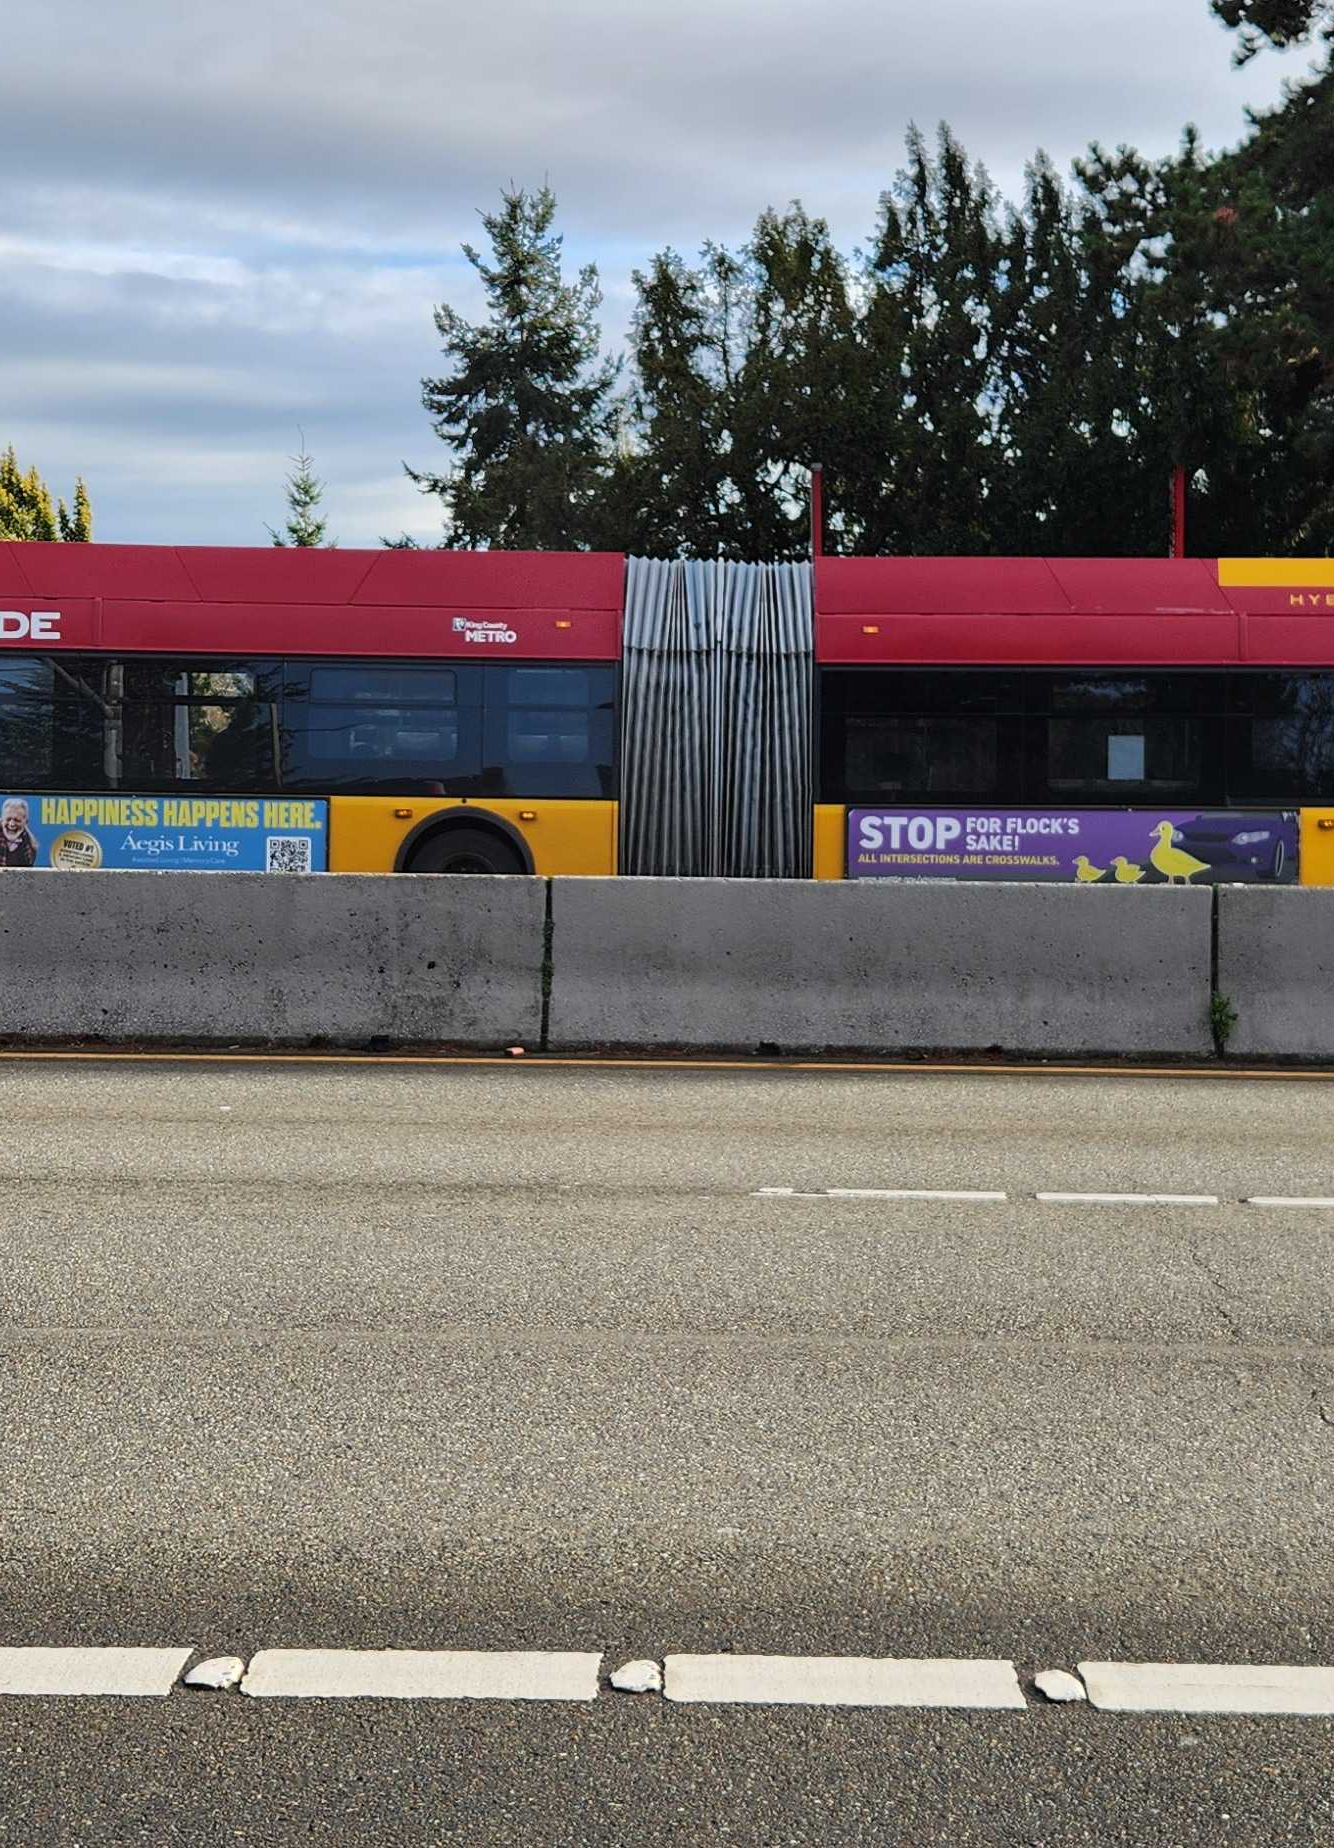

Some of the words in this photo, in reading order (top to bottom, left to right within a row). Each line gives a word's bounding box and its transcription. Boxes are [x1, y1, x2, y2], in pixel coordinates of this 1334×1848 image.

[465, 630, 517, 643] METRO
[41, 799, 159, 826] HAPPINESS
[162, 800, 260, 828] HAPPENS
[263, 802, 322, 829] HERE.
[859, 816, 961, 849] STOP
[966, 817, 1001, 833] FOR
[1006, 817, 1080, 834] FLOCK'S
[63, 839, 85, 851] VOTED
[178, 835, 240, 857] Living
[966, 835, 1020, 851] SAKE!
[858, 853, 878, 864] ALL
[879, 854, 961, 865] INTERSECTIONS
[962, 855, 983, 865] ARE
[985, 855, 1060, 866] CROSSWALKS.
